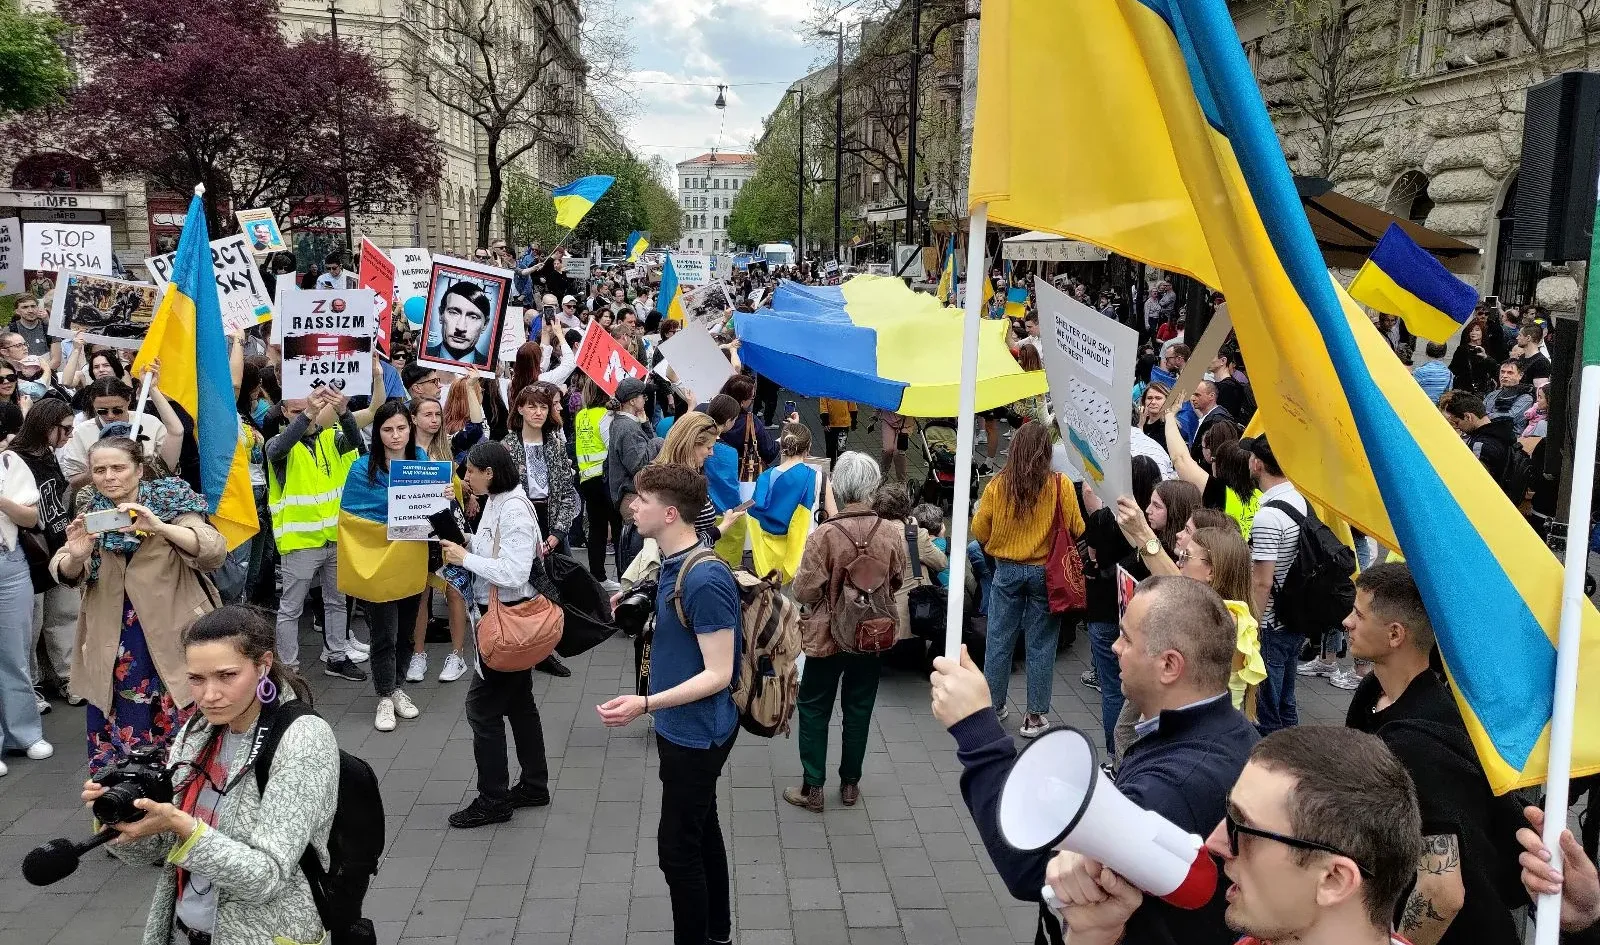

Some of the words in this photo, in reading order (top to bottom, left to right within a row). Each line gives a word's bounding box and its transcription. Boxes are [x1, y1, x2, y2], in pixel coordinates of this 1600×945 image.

[46, 196, 78, 207] MFB
[41, 229, 95, 248] STOP
[40, 251, 101, 270] RUSSIA
[405, 254, 421, 262] 2014
[215, 268, 257, 295] SKY
[292, 315, 365, 329] RASSIZM
[1055, 315, 1080, 339] SHELTER
[1081, 333, 1097, 349] OUR
[1097, 342, 1111, 356] SKY
[1056, 328, 1065, 340] WE
[1065, 334, 1080, 350] WILL
[1081, 344, 1110, 368] HANDLE
[1057, 338, 1068, 352] THE
[1068, 347, 1084, 364] REST!
[299, 361, 360, 375] FASIZM
[245, 726, 269, 766] LUMIX
